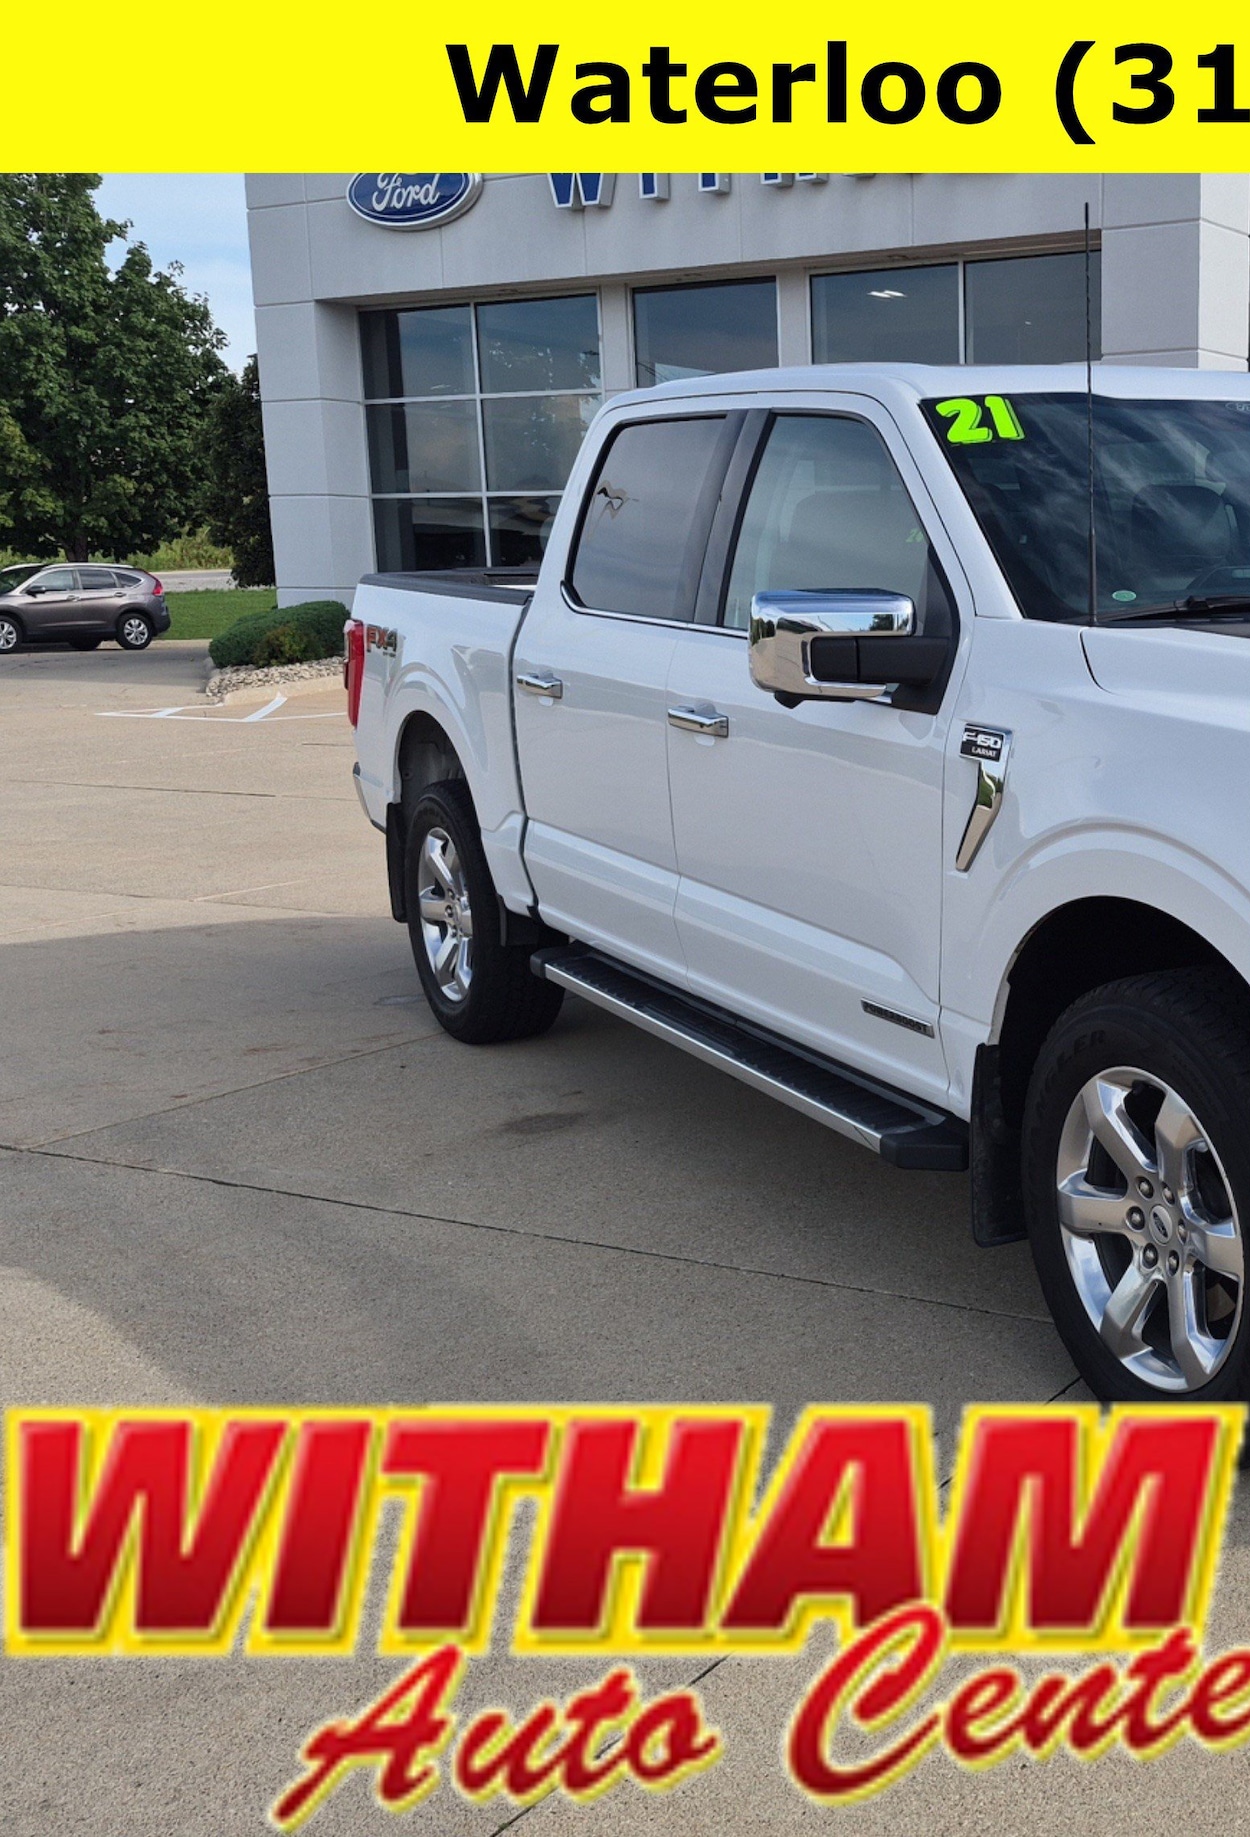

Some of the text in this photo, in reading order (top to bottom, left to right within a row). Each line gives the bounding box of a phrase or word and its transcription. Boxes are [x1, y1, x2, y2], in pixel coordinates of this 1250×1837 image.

[371, 172, 441, 212] Ford
[935, 395, 1026, 444] 21
[366, 624, 398, 653] FX4
[971, 746, 997, 758] LARIAT
